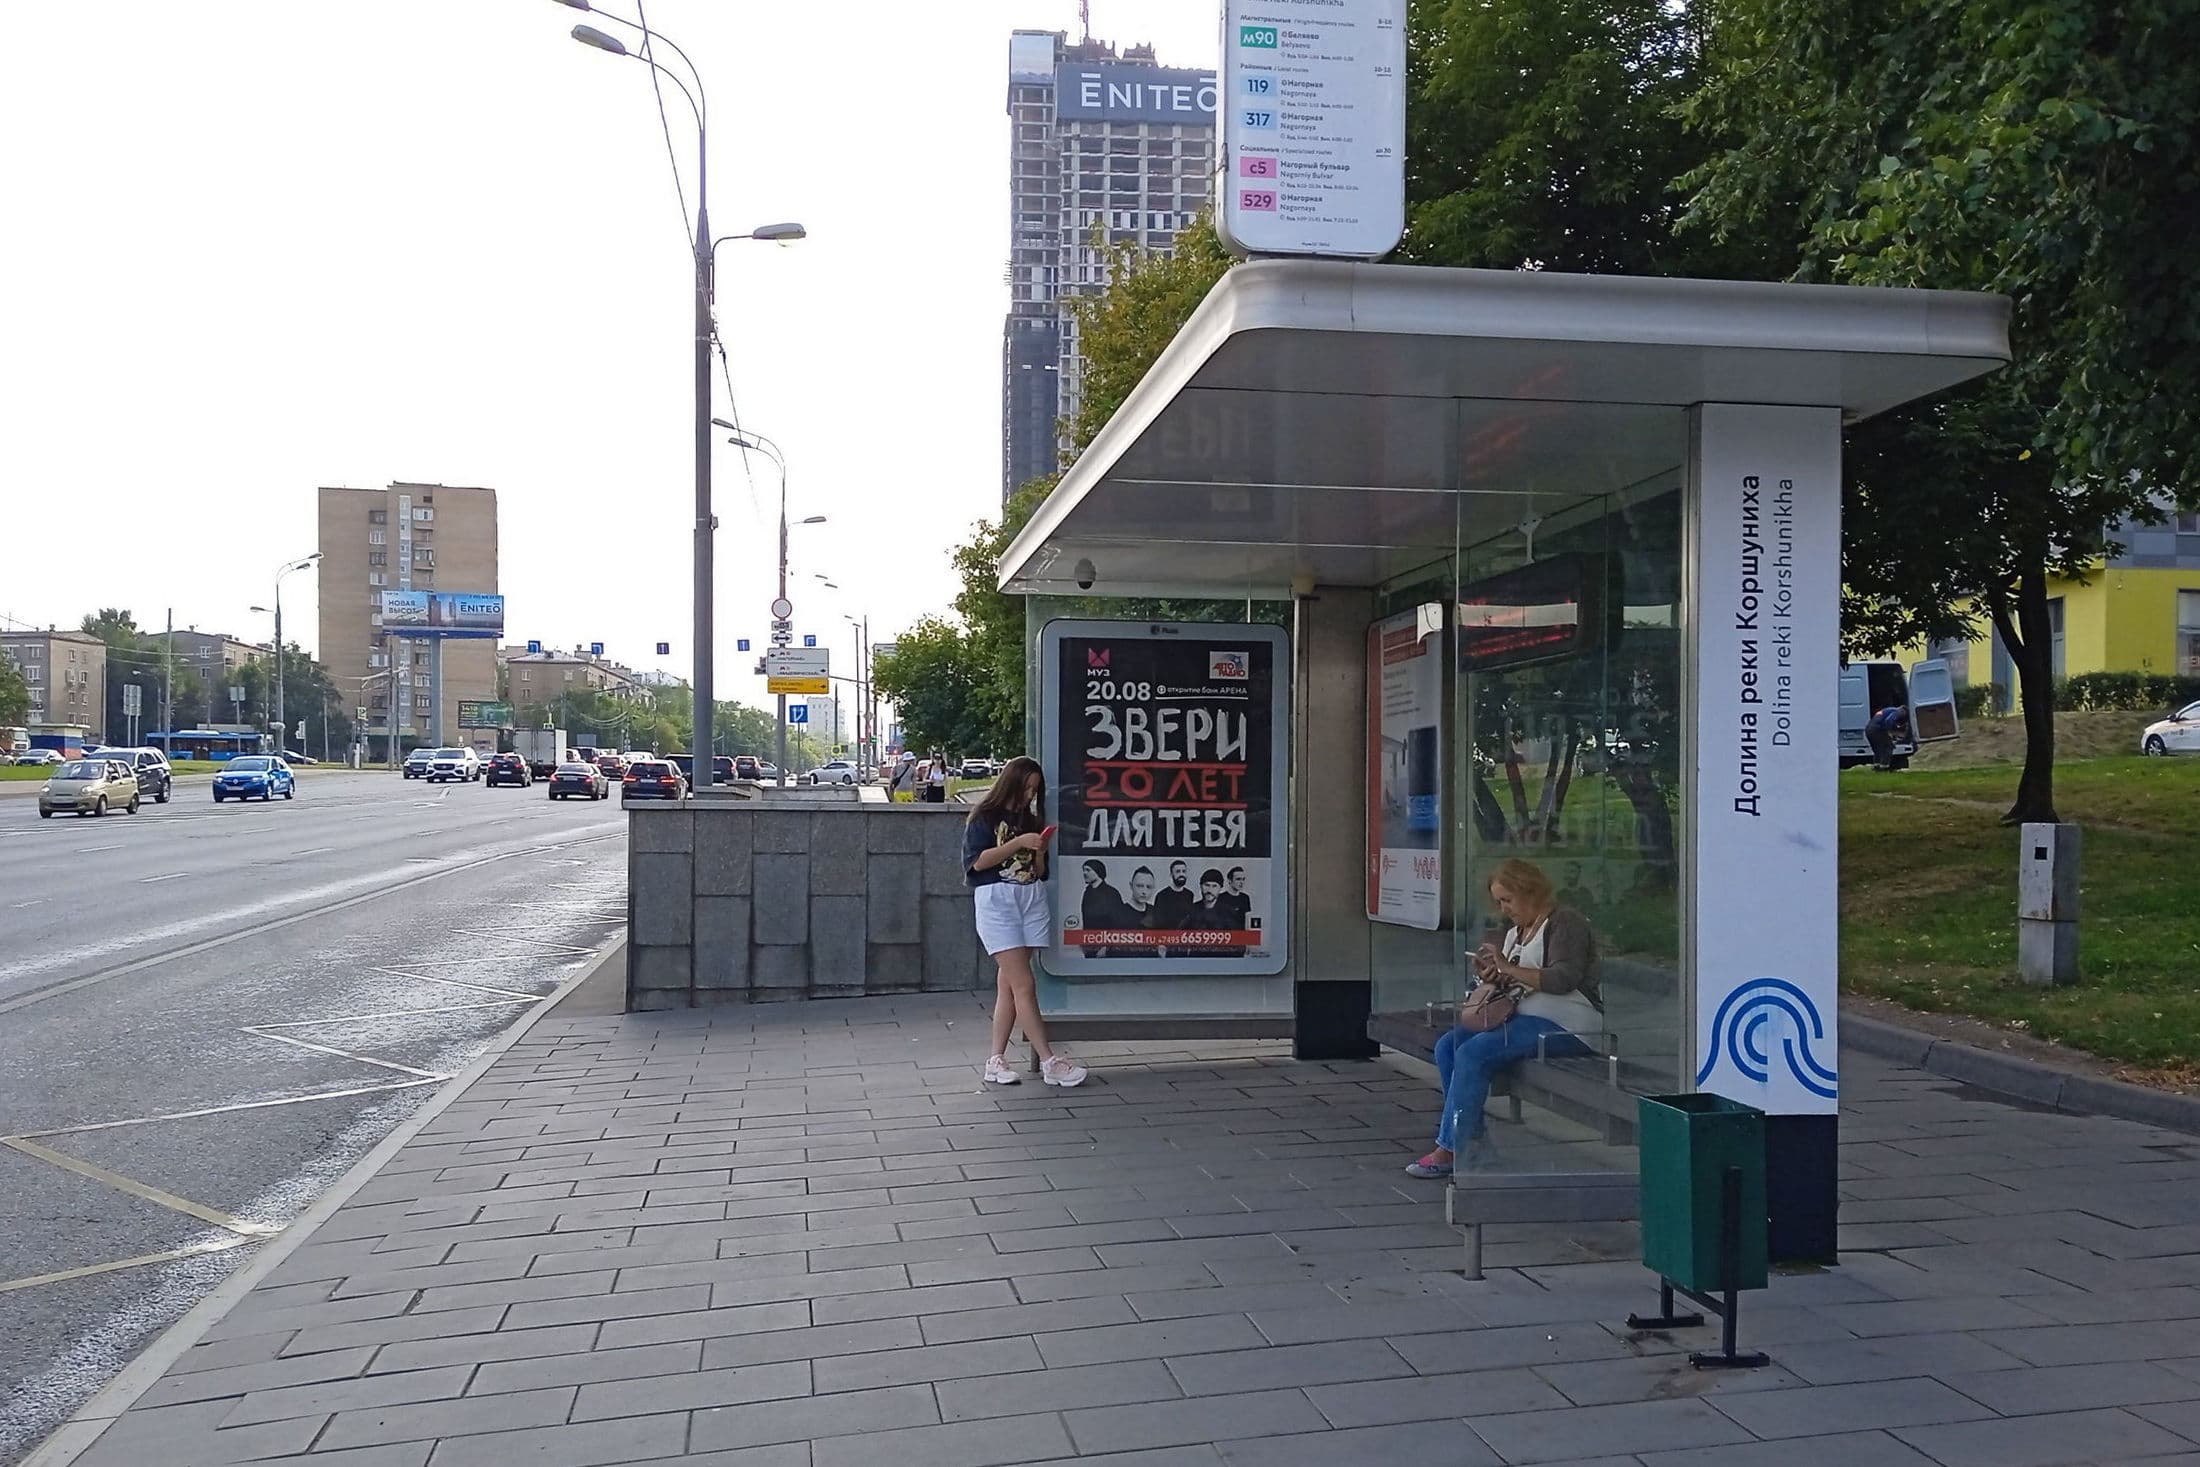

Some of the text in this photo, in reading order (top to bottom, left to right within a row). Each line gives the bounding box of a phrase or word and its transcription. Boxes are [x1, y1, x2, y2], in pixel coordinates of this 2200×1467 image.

[1247, 79, 1269, 93] 119
[1288, 80, 1324, 89] Нагорная
[1246, 112, 1270, 126] 317
[1288, 113, 1324, 122] Нагорная
[1281, 160, 1350, 172] Нагорный бульвар
[1244, 194, 1272, 208] 529
[1288, 194, 1323, 203] Нагорная
[1772, 479, 1792, 746] Dolina reki Korshunikha
[1734, 475, 1763, 816] Долина реки Коршуниха
[1087, 669, 1111, 677] МУЗ
[1087, 681, 1151, 701] 20.08
[1219, 687, 1248, 695] АРЕНА
[1084, 705, 1247, 762] ЗВЕРИ
[1085, 768, 1247, 801] 20 ЛЕТ
[1082, 809, 1246, 848] ДЛЯ ТЕБЯ
[1180, 932, 1232, 944] 6659999
